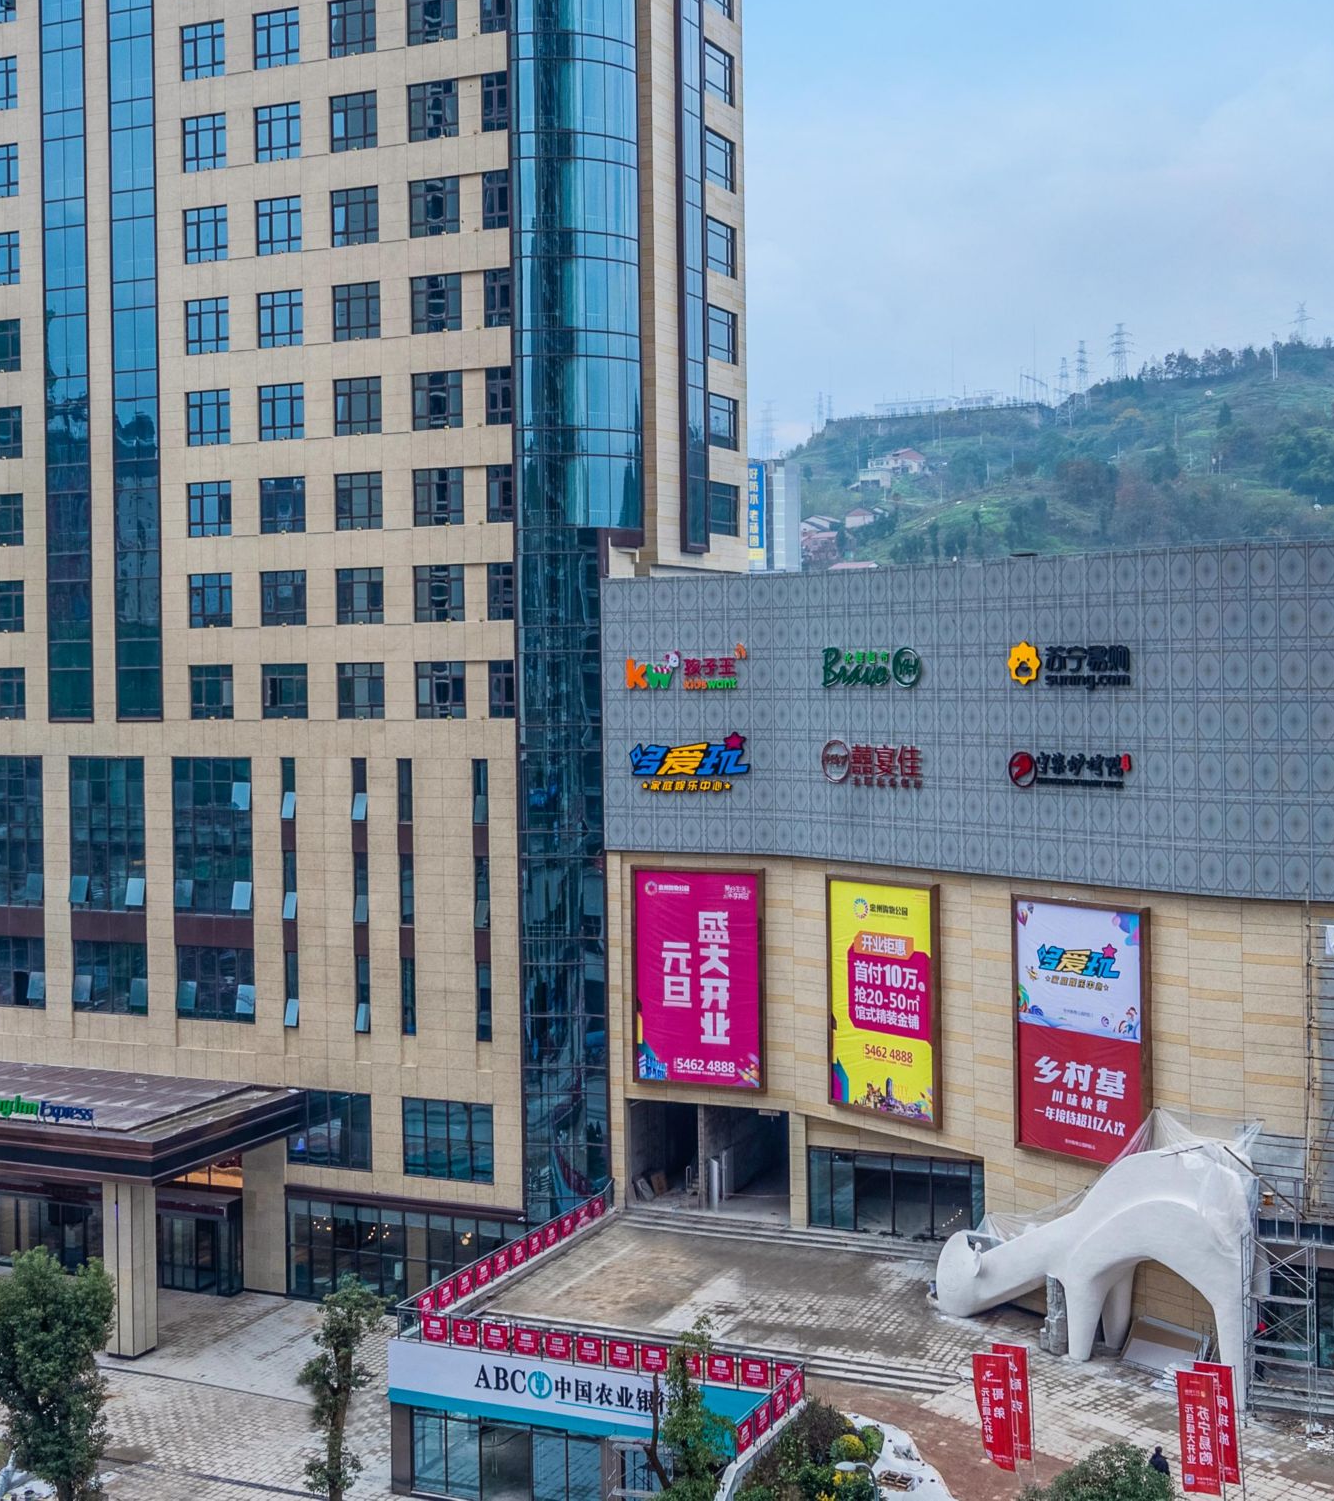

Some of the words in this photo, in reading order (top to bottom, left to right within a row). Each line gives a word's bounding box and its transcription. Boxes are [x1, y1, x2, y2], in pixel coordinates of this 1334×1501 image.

[683, 657, 737, 677] 孩子王
[1044, 645, 1131, 673] 苏宁易购
[683, 678, 738, 690] kidswant
[1044, 674, 1131, 691] suning.com
[629, 742, 751, 777] 哆爱玩
[650, 780, 723, 792] 家庭娱乐中心
[861, 934, 906, 956] 开业钜惠
[1037, 944, 1121, 979] 哆爱玩
[661, 941, 692, 1008] 元旦
[698, 910, 730, 1045] 盛大开业
[855, 1005, 920, 1031] 馆式精装金铺
[676, 1057, 705, 1071] 5462
[707, 1060, 736, 1073] 4888
[865, 1043, 887, 1059] 5462
[889, 1048, 913, 1064] 4888
[1033, 1055, 1127, 1100] 乡村基
[39, 1100, 94, 1123] Express
[1051, 1089, 1108, 1114] 川味快餐
[1034, 1106, 1126, 1137] 一年接待超1亿人次
[474, 1363, 527, 1395] ABC
